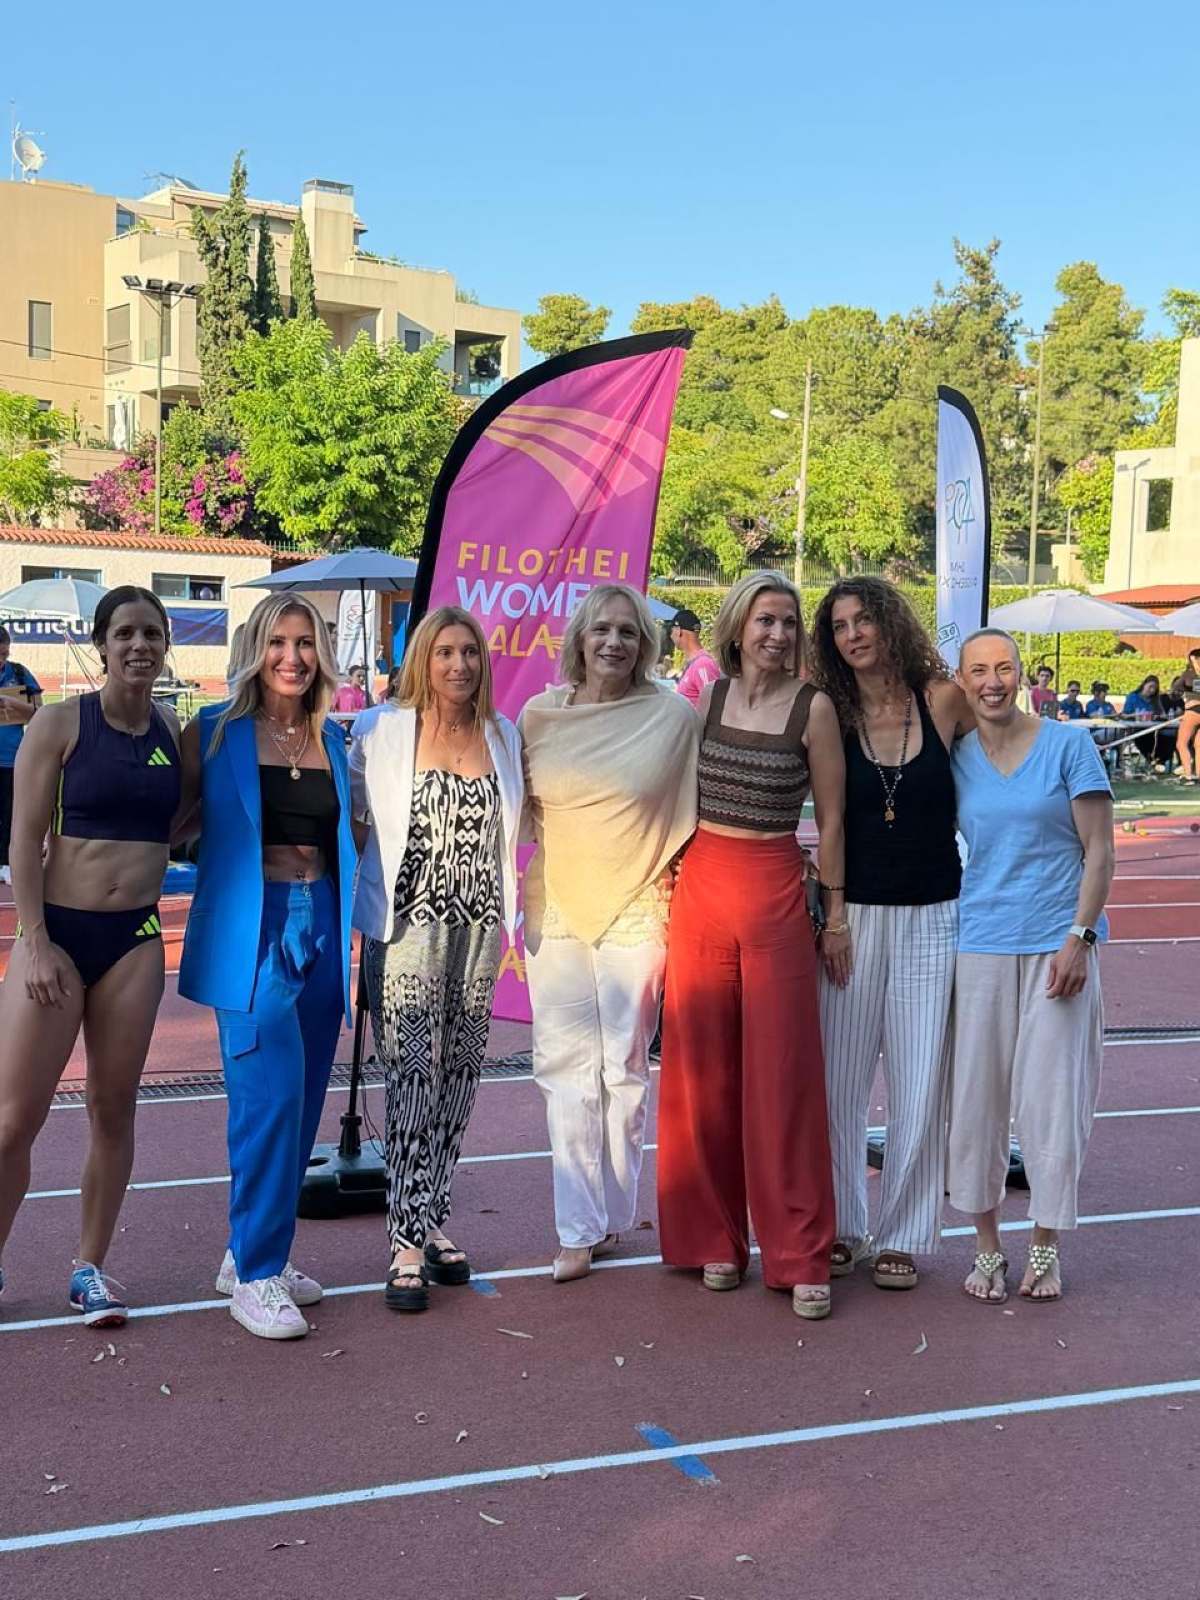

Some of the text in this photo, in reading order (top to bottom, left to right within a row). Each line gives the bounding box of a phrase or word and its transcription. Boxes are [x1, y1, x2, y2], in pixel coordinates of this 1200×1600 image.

[457, 541, 629, 580] FILOTHEI
[456, 576, 592, 619] WOME
[487, 623, 560, 660] ALA
